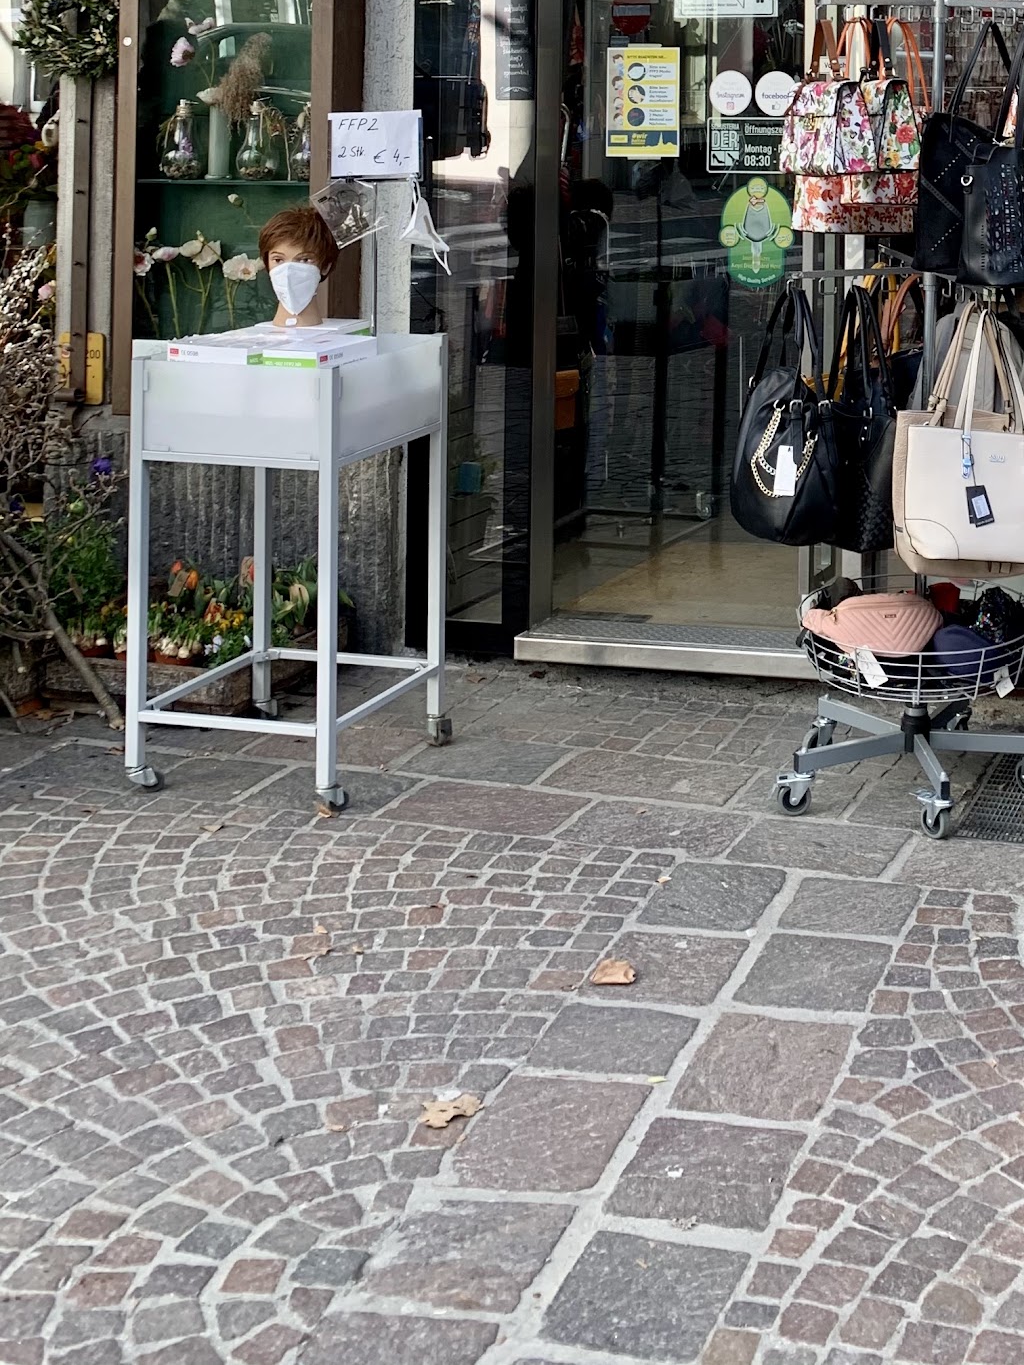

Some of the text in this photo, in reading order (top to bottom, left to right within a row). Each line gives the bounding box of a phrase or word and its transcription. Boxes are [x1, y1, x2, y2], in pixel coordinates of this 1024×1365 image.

[338, 118, 379, 132] FFP2
[338, 146, 347, 158] 2
[744, 144, 772, 155] Montag
[744, 155, 771, 167] 08:30
